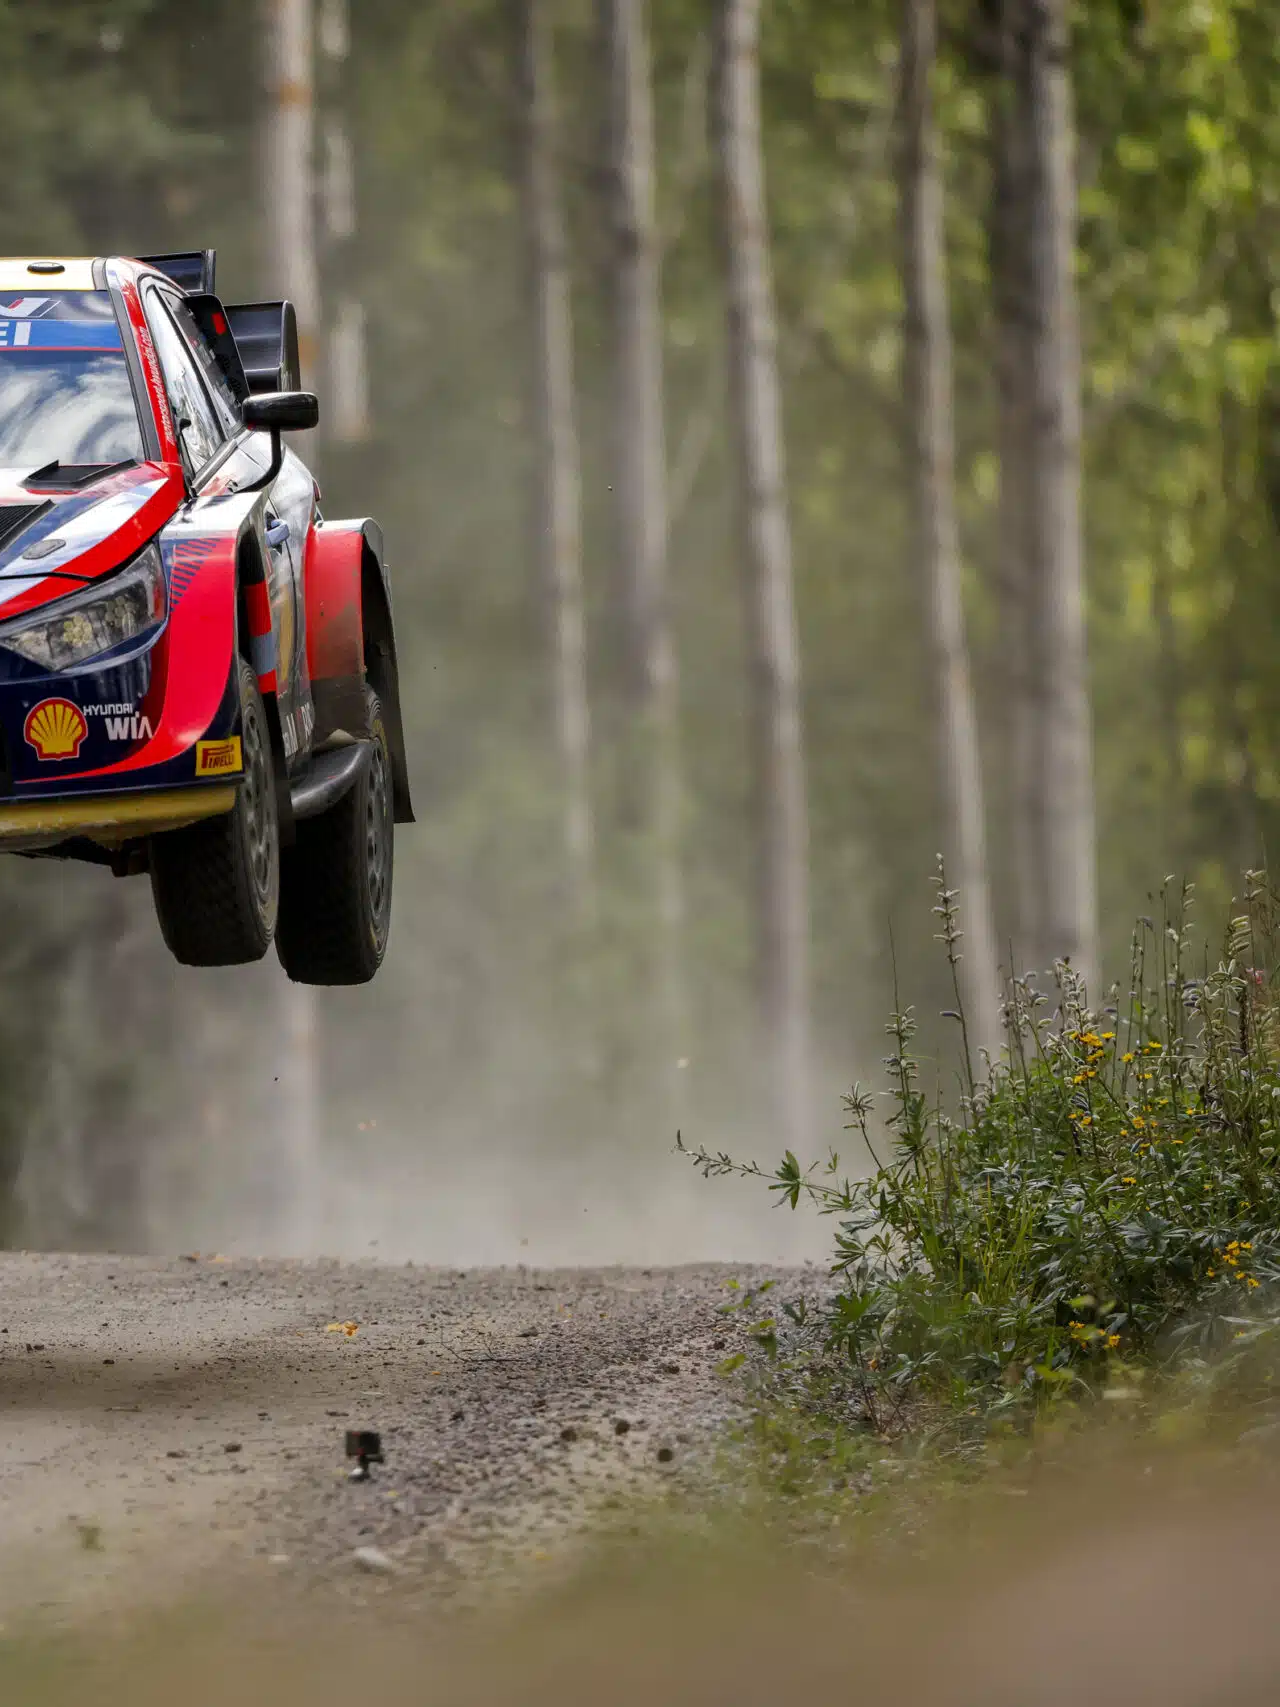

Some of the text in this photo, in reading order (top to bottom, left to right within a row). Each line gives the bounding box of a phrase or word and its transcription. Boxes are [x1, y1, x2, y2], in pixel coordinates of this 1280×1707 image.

[82, 703, 133, 716] HYUNDAI
[104, 711, 153, 741] WIA
[201, 744, 235, 769] PIRELLI
